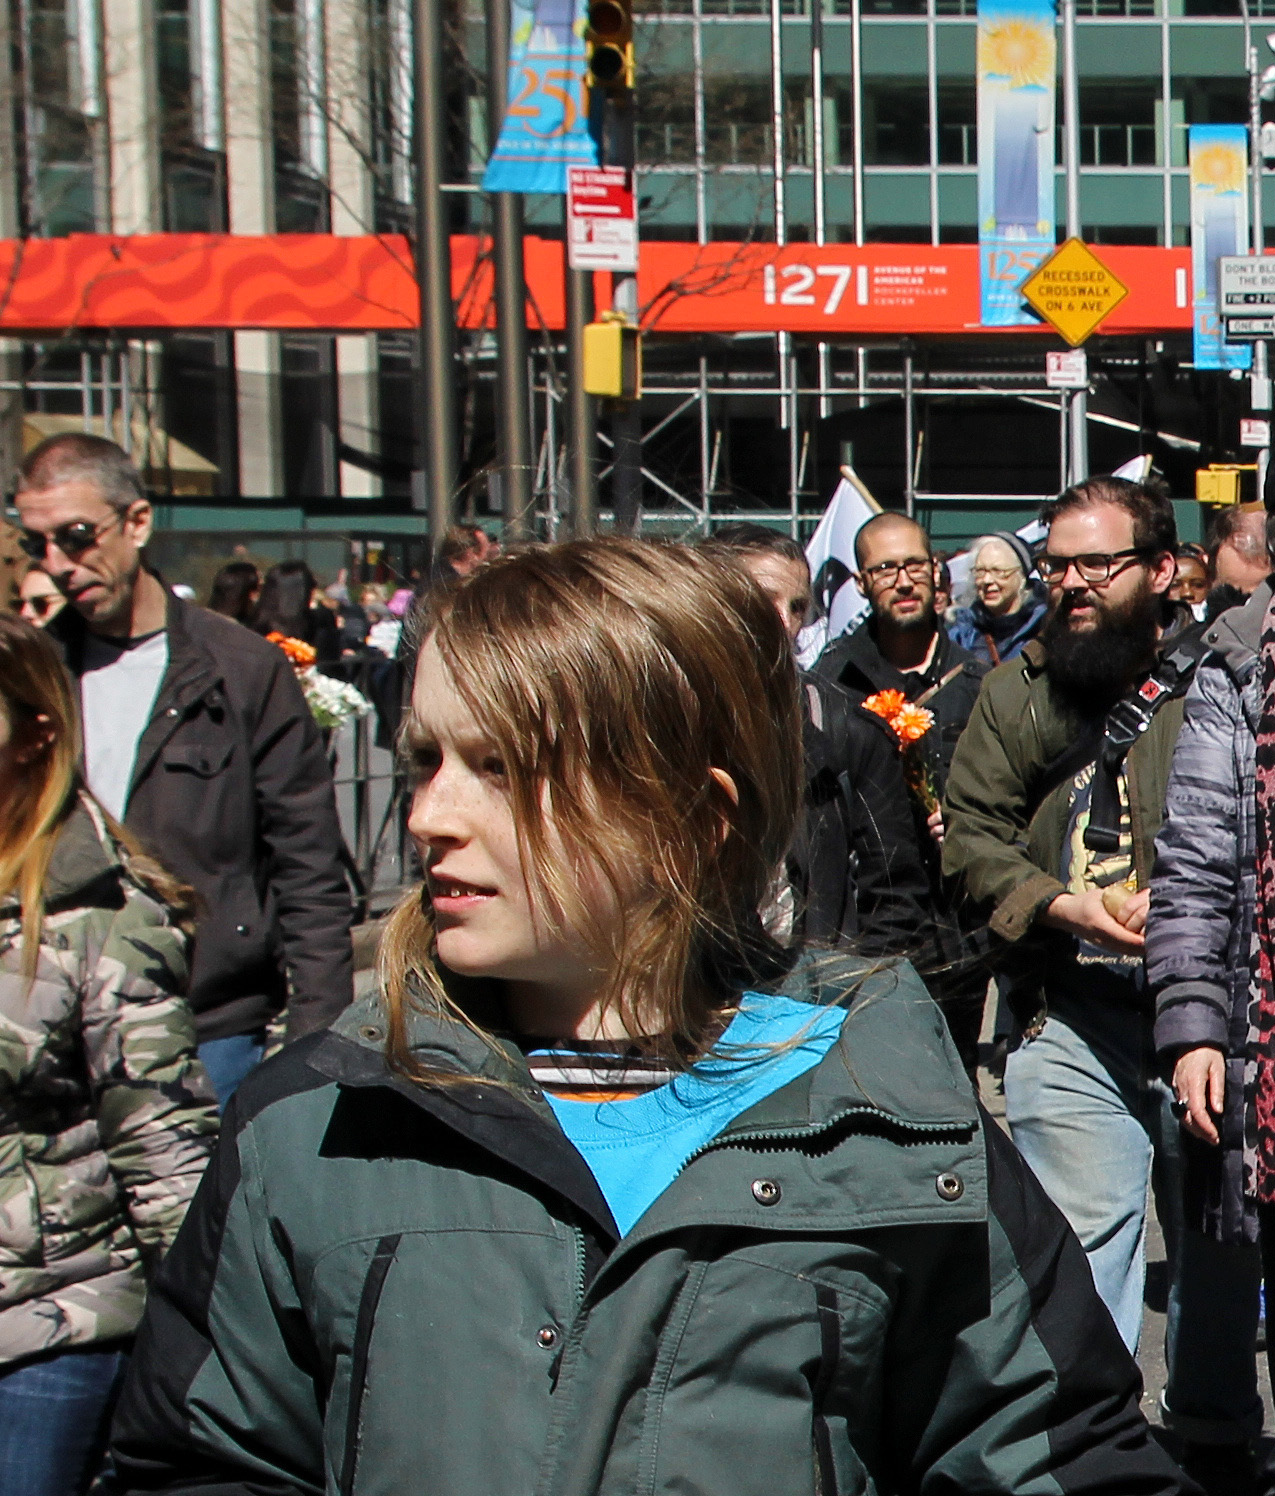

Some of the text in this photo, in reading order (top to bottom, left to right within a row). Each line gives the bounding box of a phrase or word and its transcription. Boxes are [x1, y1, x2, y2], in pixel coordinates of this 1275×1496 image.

[1225, 263, 1255, 274] DON'T
[1043, 270, 1105, 282] RECESSED
[1239, 276, 1257, 286] THE
[764, 264, 869, 315] 1271
[1038, 286, 1111, 297] CROSSWALK
[1046, 302, 1104, 312] ON 6 AVE
